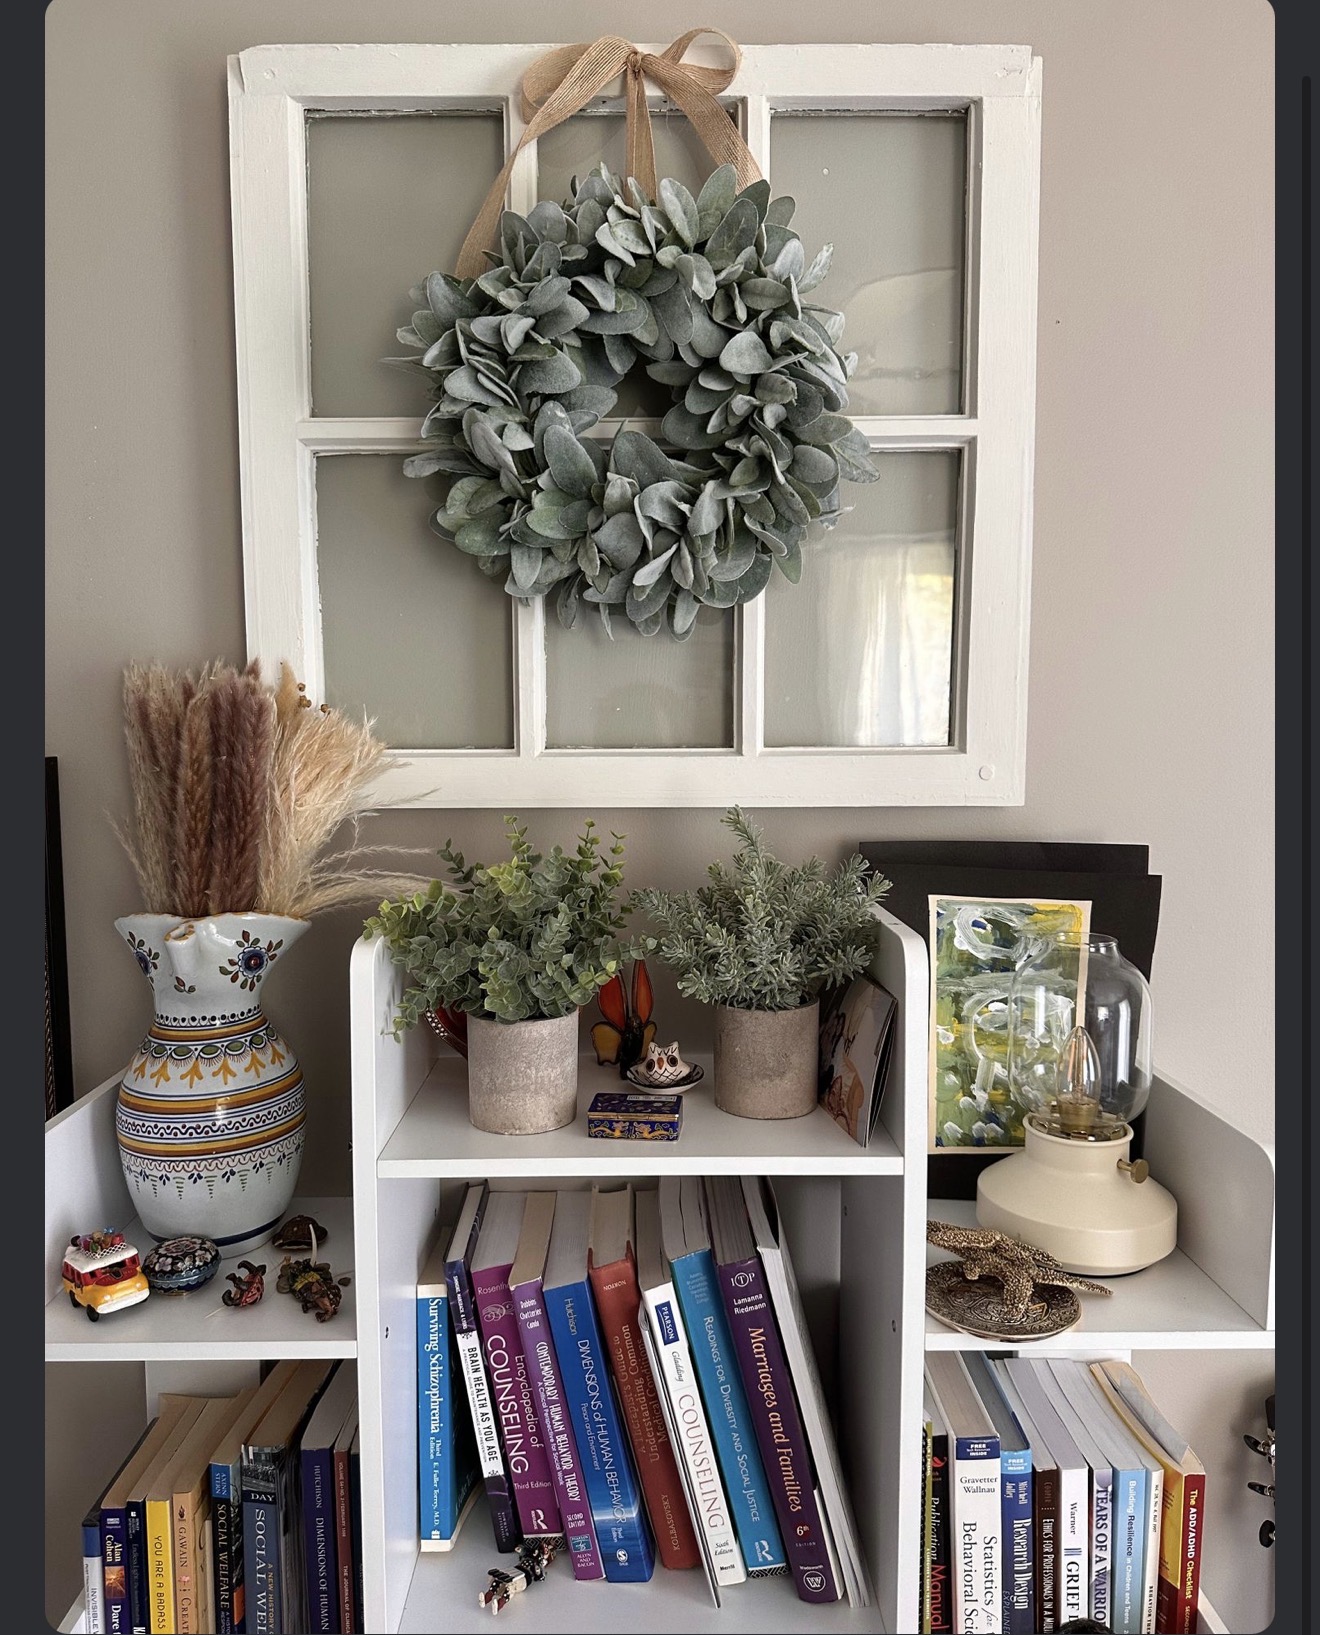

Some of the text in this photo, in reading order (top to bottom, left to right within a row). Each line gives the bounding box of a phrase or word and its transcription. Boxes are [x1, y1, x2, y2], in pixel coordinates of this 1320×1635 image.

[603, 1279, 627, 1291] NORTON
[733, 1293, 763, 1306] Lamanna
[563, 1298, 578, 1336] Hutchison
[661, 1306, 675, 1340] PEARSON
[734, 1302, 767, 1315] Riedmann
[613, 1335, 620, 1345] to
[703, 1315, 721, 1363] READINGS
[424, 1298, 443, 1433] Surviving Schizophrenia
[614, 1349, 629, 1382] Guide
[671, 1351, 684, 1382] Gladding
[715, 1364, 726, 1383] FOR
[467, 1346, 499, 1462] BRAIN HEALTH AS YOU AGE
[487, 1335, 529, 1474] COUNSELING
[515, 1354, 544, 1448] Encyclopedia of
[621, 1324, 660, 1462] Understanding Common
[639, 1339, 668, 1442] Medical Conditions
[720, 1384, 737, 1429] DIVERSITY
[536, 1341, 581, 1501] CONTEMPORARY HUMAN BEHAVIOR THEORY
[538, 1387, 548, 1408] Critical
[543, 1408, 555, 1443] Perspective
[552, 1452, 561, 1471] Social
[577, 1339, 627, 1523] DIMENSIONS of HUMAN BEHAVIOR
[581, 1402, 601, 1471] Person and Environment
[748, 1327, 802, 1513] Marriages and Families
[731, 1432, 743, 1452] AND
[678, 1394, 725, 1528] COUNSELING
[737, 1454, 751, 1488] SOCIAL
[251, 1492, 275, 1502] DAY
[313, 1465, 323, 1509] HUTCHISON
[514, 1481, 552, 1490] Third Edition
[959, 1476, 998, 1484] Gravetter
[1127, 1480, 1137, 1513] Building
[1189, 1489, 1198, 1505] The
[566, 1512, 584, 1521] SECOND
[661, 1494, 681, 1551] KOLBASOVSKY
[742, 1489, 761, 1523] JUSTICE
[1070, 1502, 1078, 1535] Warner
[1095, 1487, 1108, 1530] TEARS
[568, 1520, 586, 1529] EDITION
[931, 1497, 941, 1560] Publication
[1042, 1518, 1055, 1539] ETHICS
[1126, 1515, 1135, 1556] Resilience
[1187, 1507, 1198, 1559] ADD/ADHD
[105, 1534, 115, 1562] Cohen
[114, 1541, 123, 1562] Alan
[154, 1535, 162, 1556] YOU
[178, 1527, 188, 1568] GAWAIN
[217, 1503, 230, 1609] SOCIAL WELFARE
[714, 1548, 734, 1556] Edition
[715, 1540, 730, 1549] Sixth
[1043, 1540, 1053, 1553] FOR
[1095, 1533, 1108, 1552] OF
[1095, 1554, 1107, 1564] A
[155, 1560, 164, 1578] ARE
[255, 1508, 267, 1634] SOCIAL WEL
[315, 1517, 330, 1630] DIMENSIONS OF HUMAN
[962, 1521, 978, 1603] Behavioral
[1009, 1518, 1033, 1610] Research Design
[1042, 1554, 1055, 1601] PROFESSIONALS
[1125, 1565, 1133, 1591] Children
[931, 1564, 950, 1630] Manual
[981, 1536, 999, 1627] Statistics for
[1066, 1561, 1080, 1611] GRIEF
[1185, 1561, 1195, 1599] Checklist
[111, 1604, 122, 1630] Dare
[156, 1593, 166, 1630] BADASS
[344, 1603, 350, 1611] OF
[1043, 1601, 1054, 1609] IN
[1123, 1605, 1131, 1624] Teens
